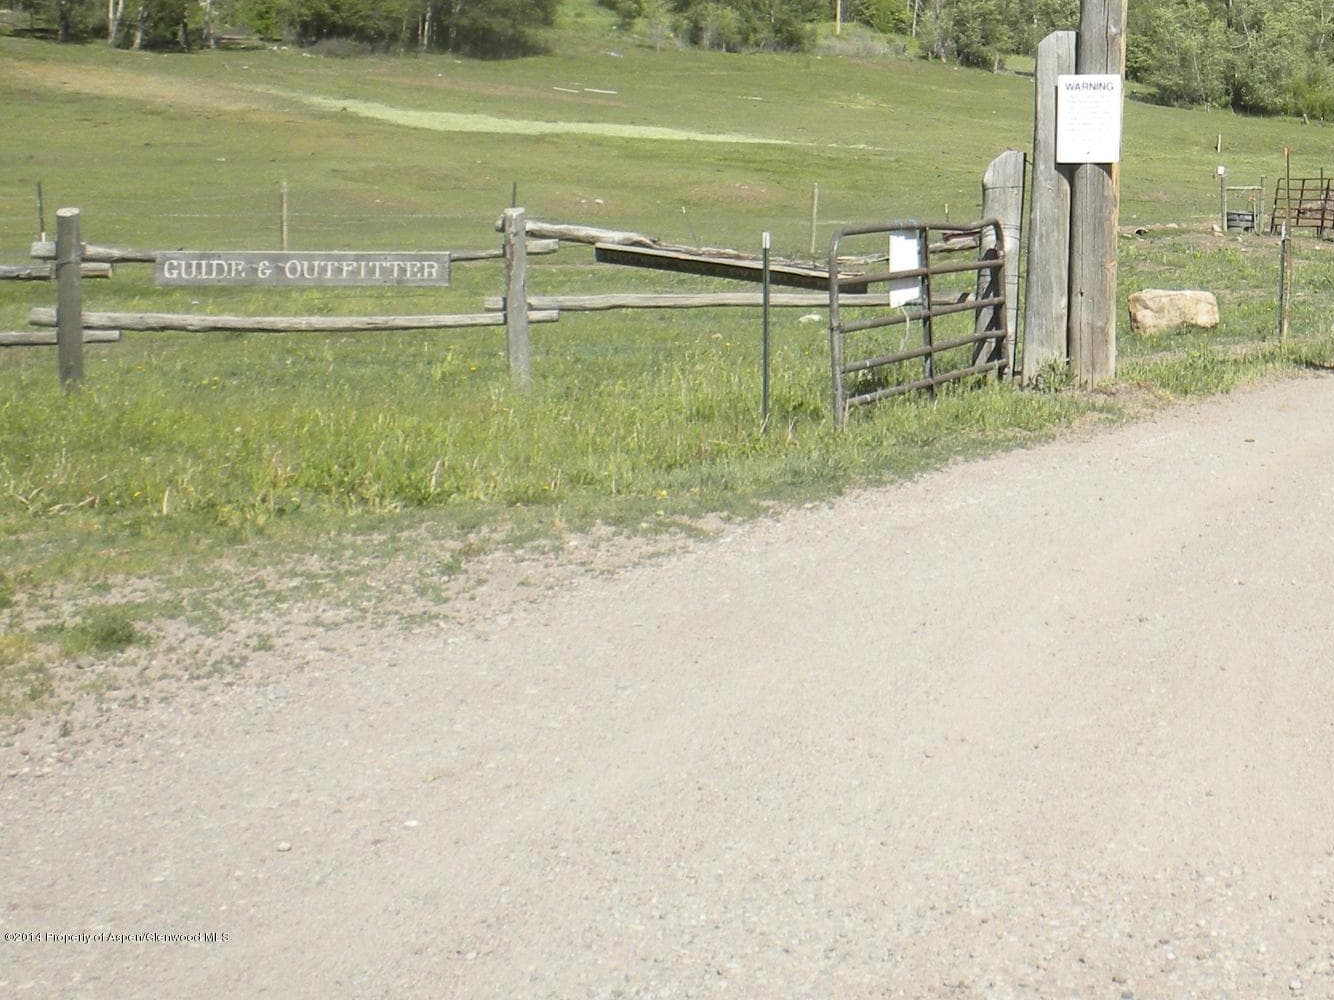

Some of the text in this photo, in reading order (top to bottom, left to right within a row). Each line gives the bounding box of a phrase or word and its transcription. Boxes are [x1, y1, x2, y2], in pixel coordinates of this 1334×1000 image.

[1065, 82, 1114, 91] WARNING
[163, 260, 439, 280] GUIDE & OUTFITTER
